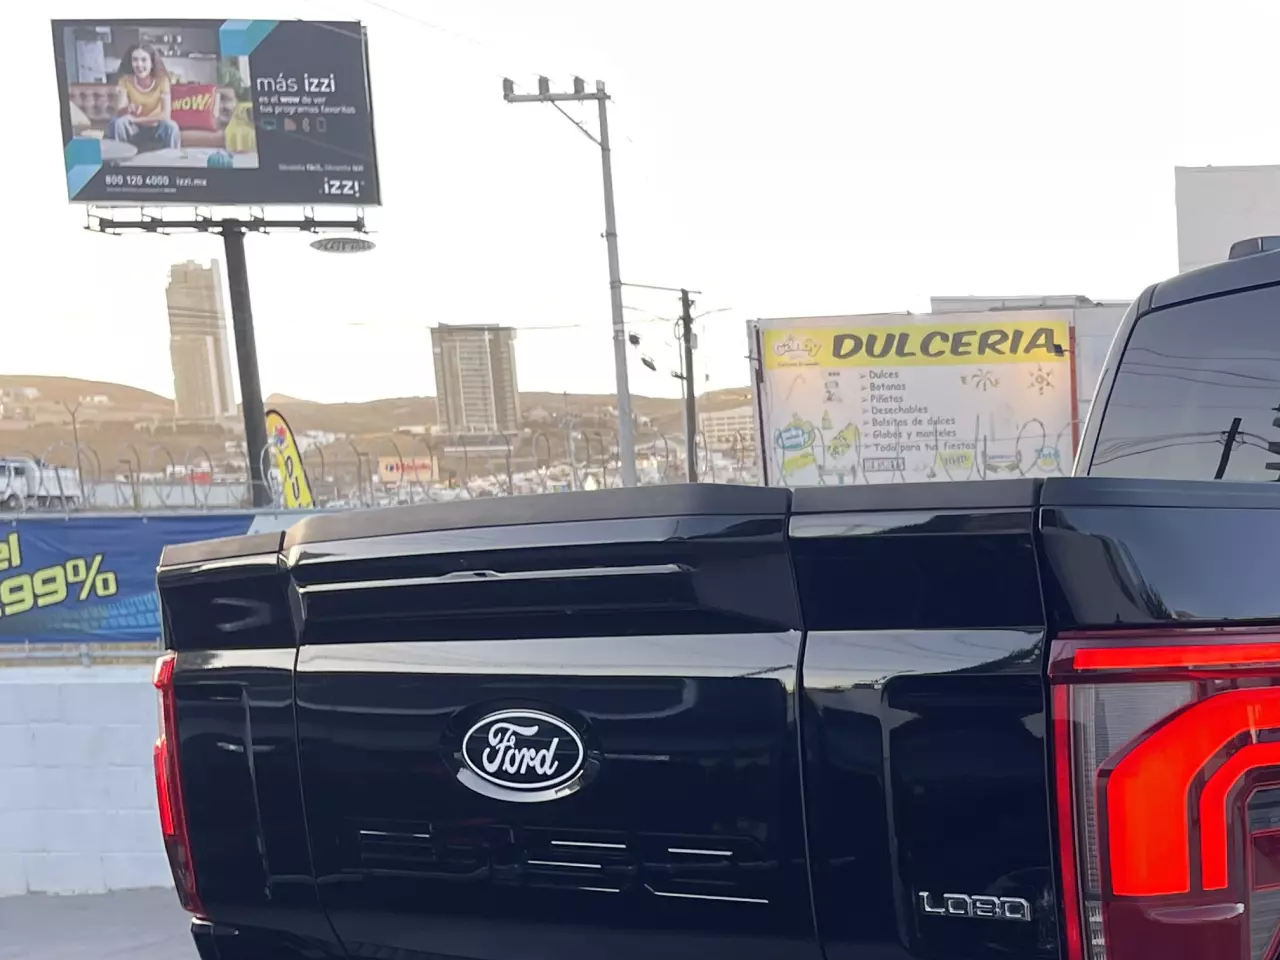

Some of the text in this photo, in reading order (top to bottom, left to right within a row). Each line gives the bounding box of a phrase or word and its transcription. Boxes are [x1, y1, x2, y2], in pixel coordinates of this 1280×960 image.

[256, 72, 336, 93] más izzi
[126, 174, 143, 186] 120
[145, 175, 169, 186] 4000
[831, 327, 1065, 359] DULCERIA
[869, 369, 899, 379] Dulces
[870, 382, 906, 391] Botanas
[872, 405, 928, 415] Desechables
[872, 415, 956, 426] Bolsitas de dulces
[872, 428, 957, 439] Globos y manteles
[873, 440, 976, 454] Todo para tus fiestas
[482, 722, 559, 775] Ford
